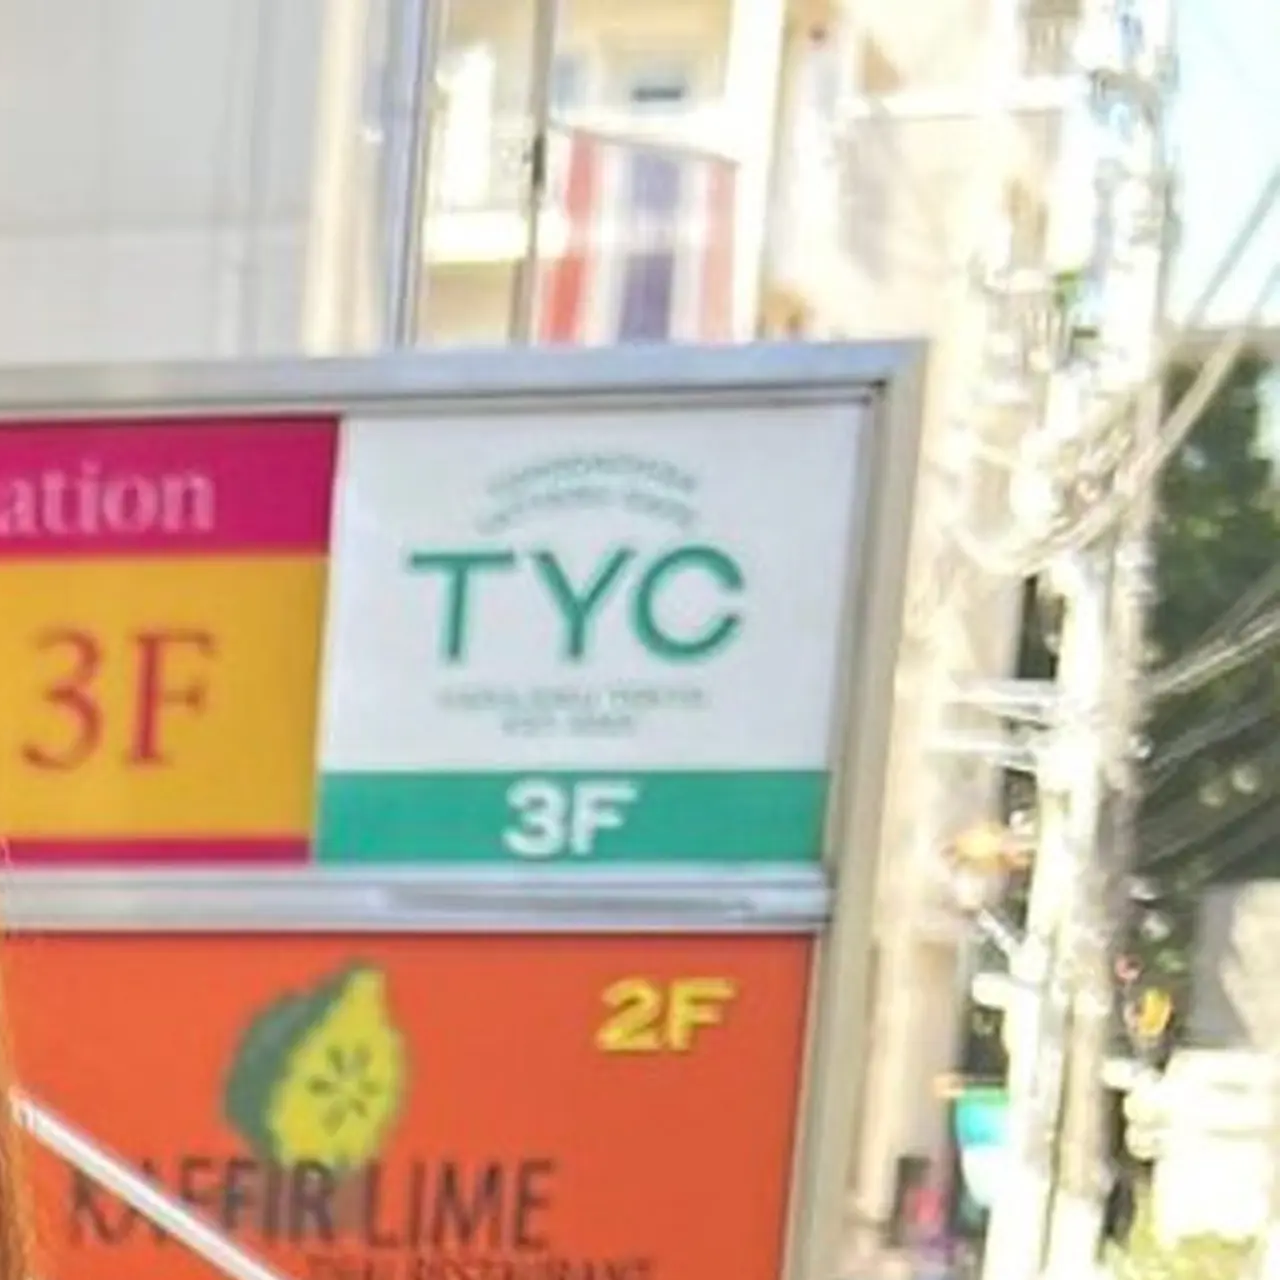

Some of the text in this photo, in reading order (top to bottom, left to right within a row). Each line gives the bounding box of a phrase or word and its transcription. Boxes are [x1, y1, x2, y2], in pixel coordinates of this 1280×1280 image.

[403, 540, 747, 665] TYC
[20, 624, 220, 772] 3F
[502, 777, 640, 858] 3F
[594, 975, 739, 1053] 2F
[364, 1157, 557, 1254] LIME
